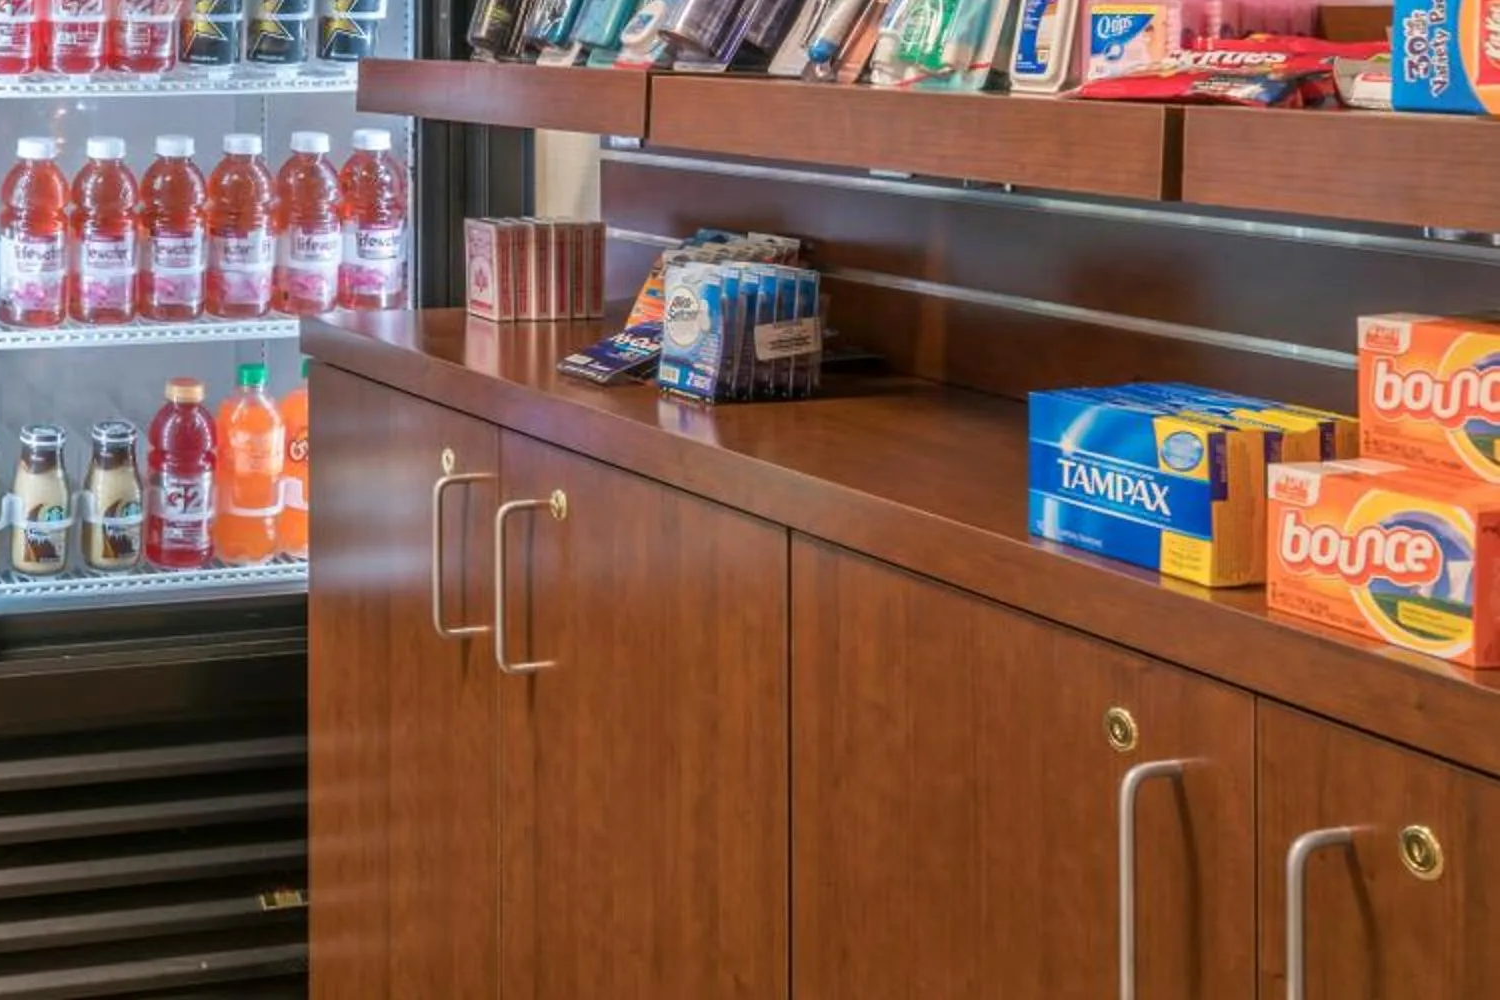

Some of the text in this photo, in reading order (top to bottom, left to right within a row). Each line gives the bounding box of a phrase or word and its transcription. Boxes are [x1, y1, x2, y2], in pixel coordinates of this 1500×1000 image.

[1404, 36, 1430, 83] 30
[1374, 358, 1500, 419] bounc
[1057, 457, 1172, 516] TAMPAX
[1281, 511, 1434, 576] bounce
